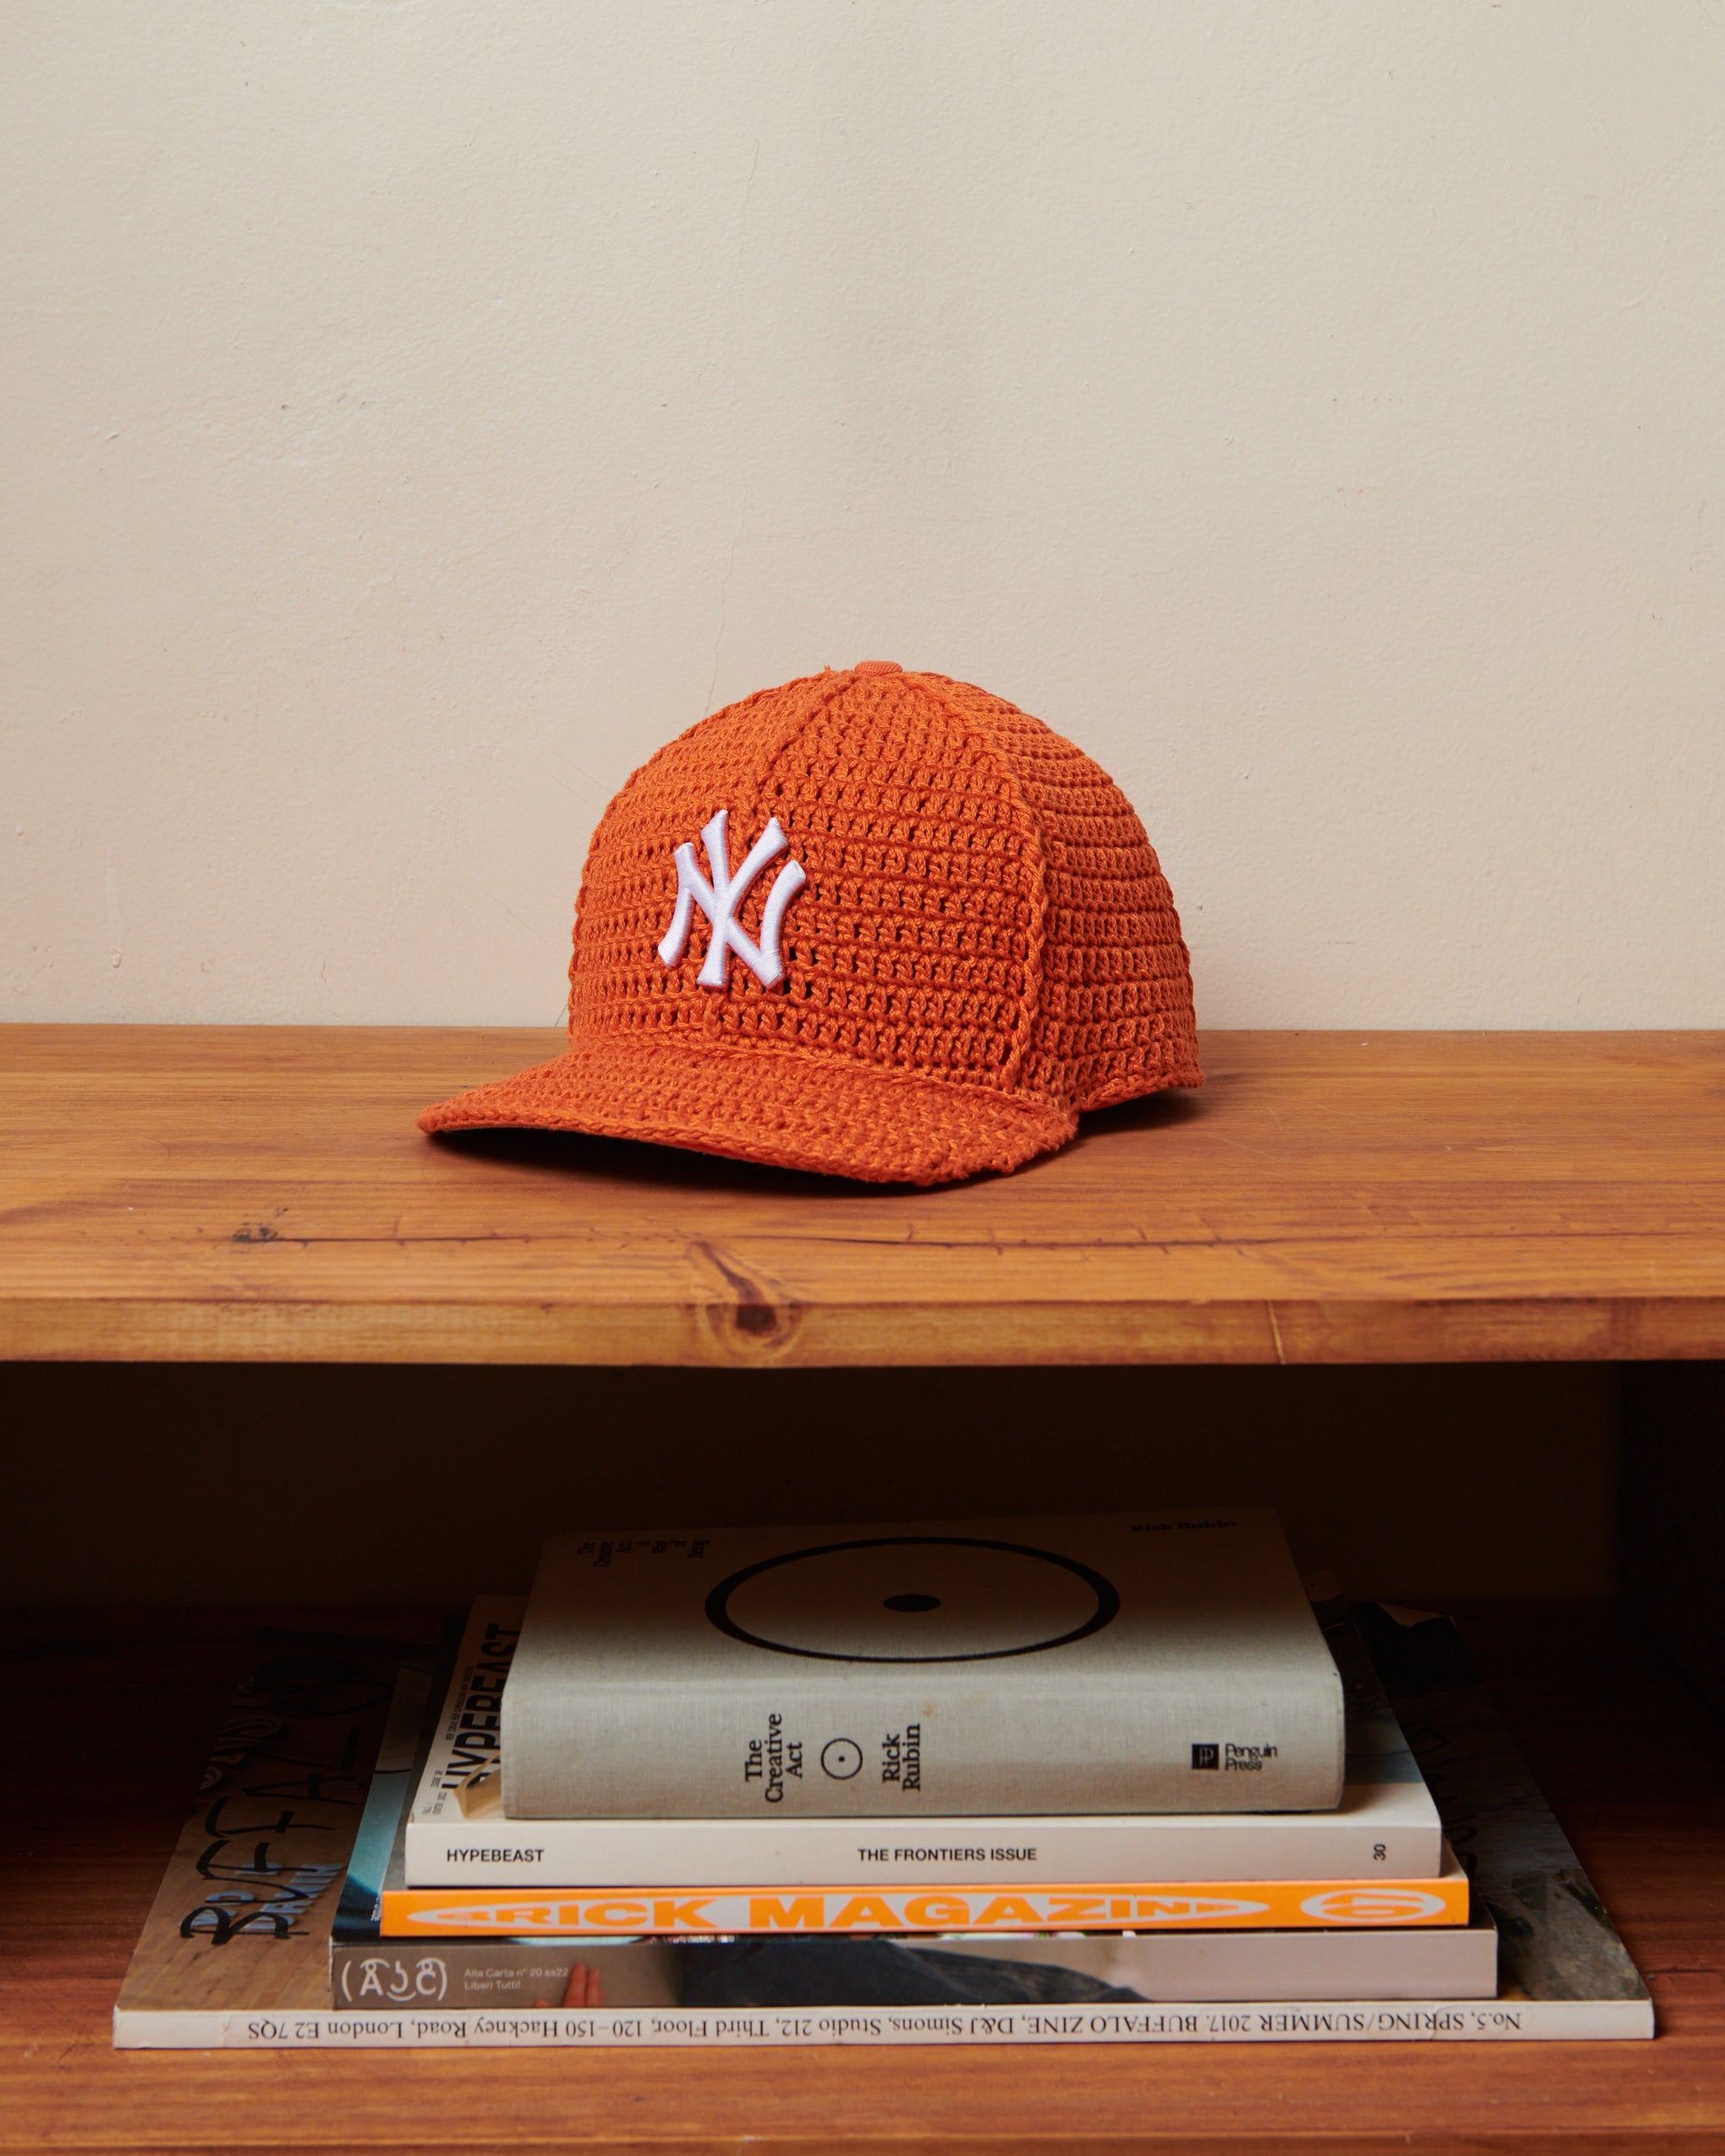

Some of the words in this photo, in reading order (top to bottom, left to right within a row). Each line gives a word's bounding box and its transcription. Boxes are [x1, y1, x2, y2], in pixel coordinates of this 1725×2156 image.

[658, 810, 806, 989] NY
[745, 1739, 762, 1782] The
[765, 1714, 783, 1802] Creative
[786, 1741, 802, 1778] Act
[882, 1733, 900, 1783] Rick
[902, 1724, 920, 1791] Rubin
[1226, 1758, 1263, 1771] Press
[446, 1849, 544, 1863] HYPEBEAST
[857, 1848, 889, 1861] THE
[894, 1848, 986, 1861] FRONTIERS
[990, 1848, 1037, 1861] ISSUE
[1373, 1844, 1386, 1861] 30
[436, 1900, 718, 1927] BRICK
[749, 1896, 1239, 1927] MAGAZINE
[464, 1968, 483, 1977] Alla
[485, 1968, 514, 1977] Carta
[530, 1968, 543, 1977] 20
[464, 1981, 492, 1990] Liberi
[248, 2020, 286, 2040] 7QS
[295, 2021, 320, 2039] E2
[328, 2021, 403, 2039] London
[411, 2019, 466, 2039] Road,
[474, 2017, 558, 2038] Hackney
[650, 2018, 707, 2038] Floor,
[716, 2020, 769, 2037] Third
[776, 2017, 812, 2037] 212,
[819, 2018, 881, 2037] Studio
[888, 2015, 963, 2035] Simons,
[970, 2017, 1013, 2034] D&J
[1021, 2014, 1083, 2034] ZINE,
[1090, 2015, 1198, 2033] BUFFALO
[1259, 2013, 1464, 2032] SPRING/SUMMER
[1471, 2011, 1521, 2030] No.5,
